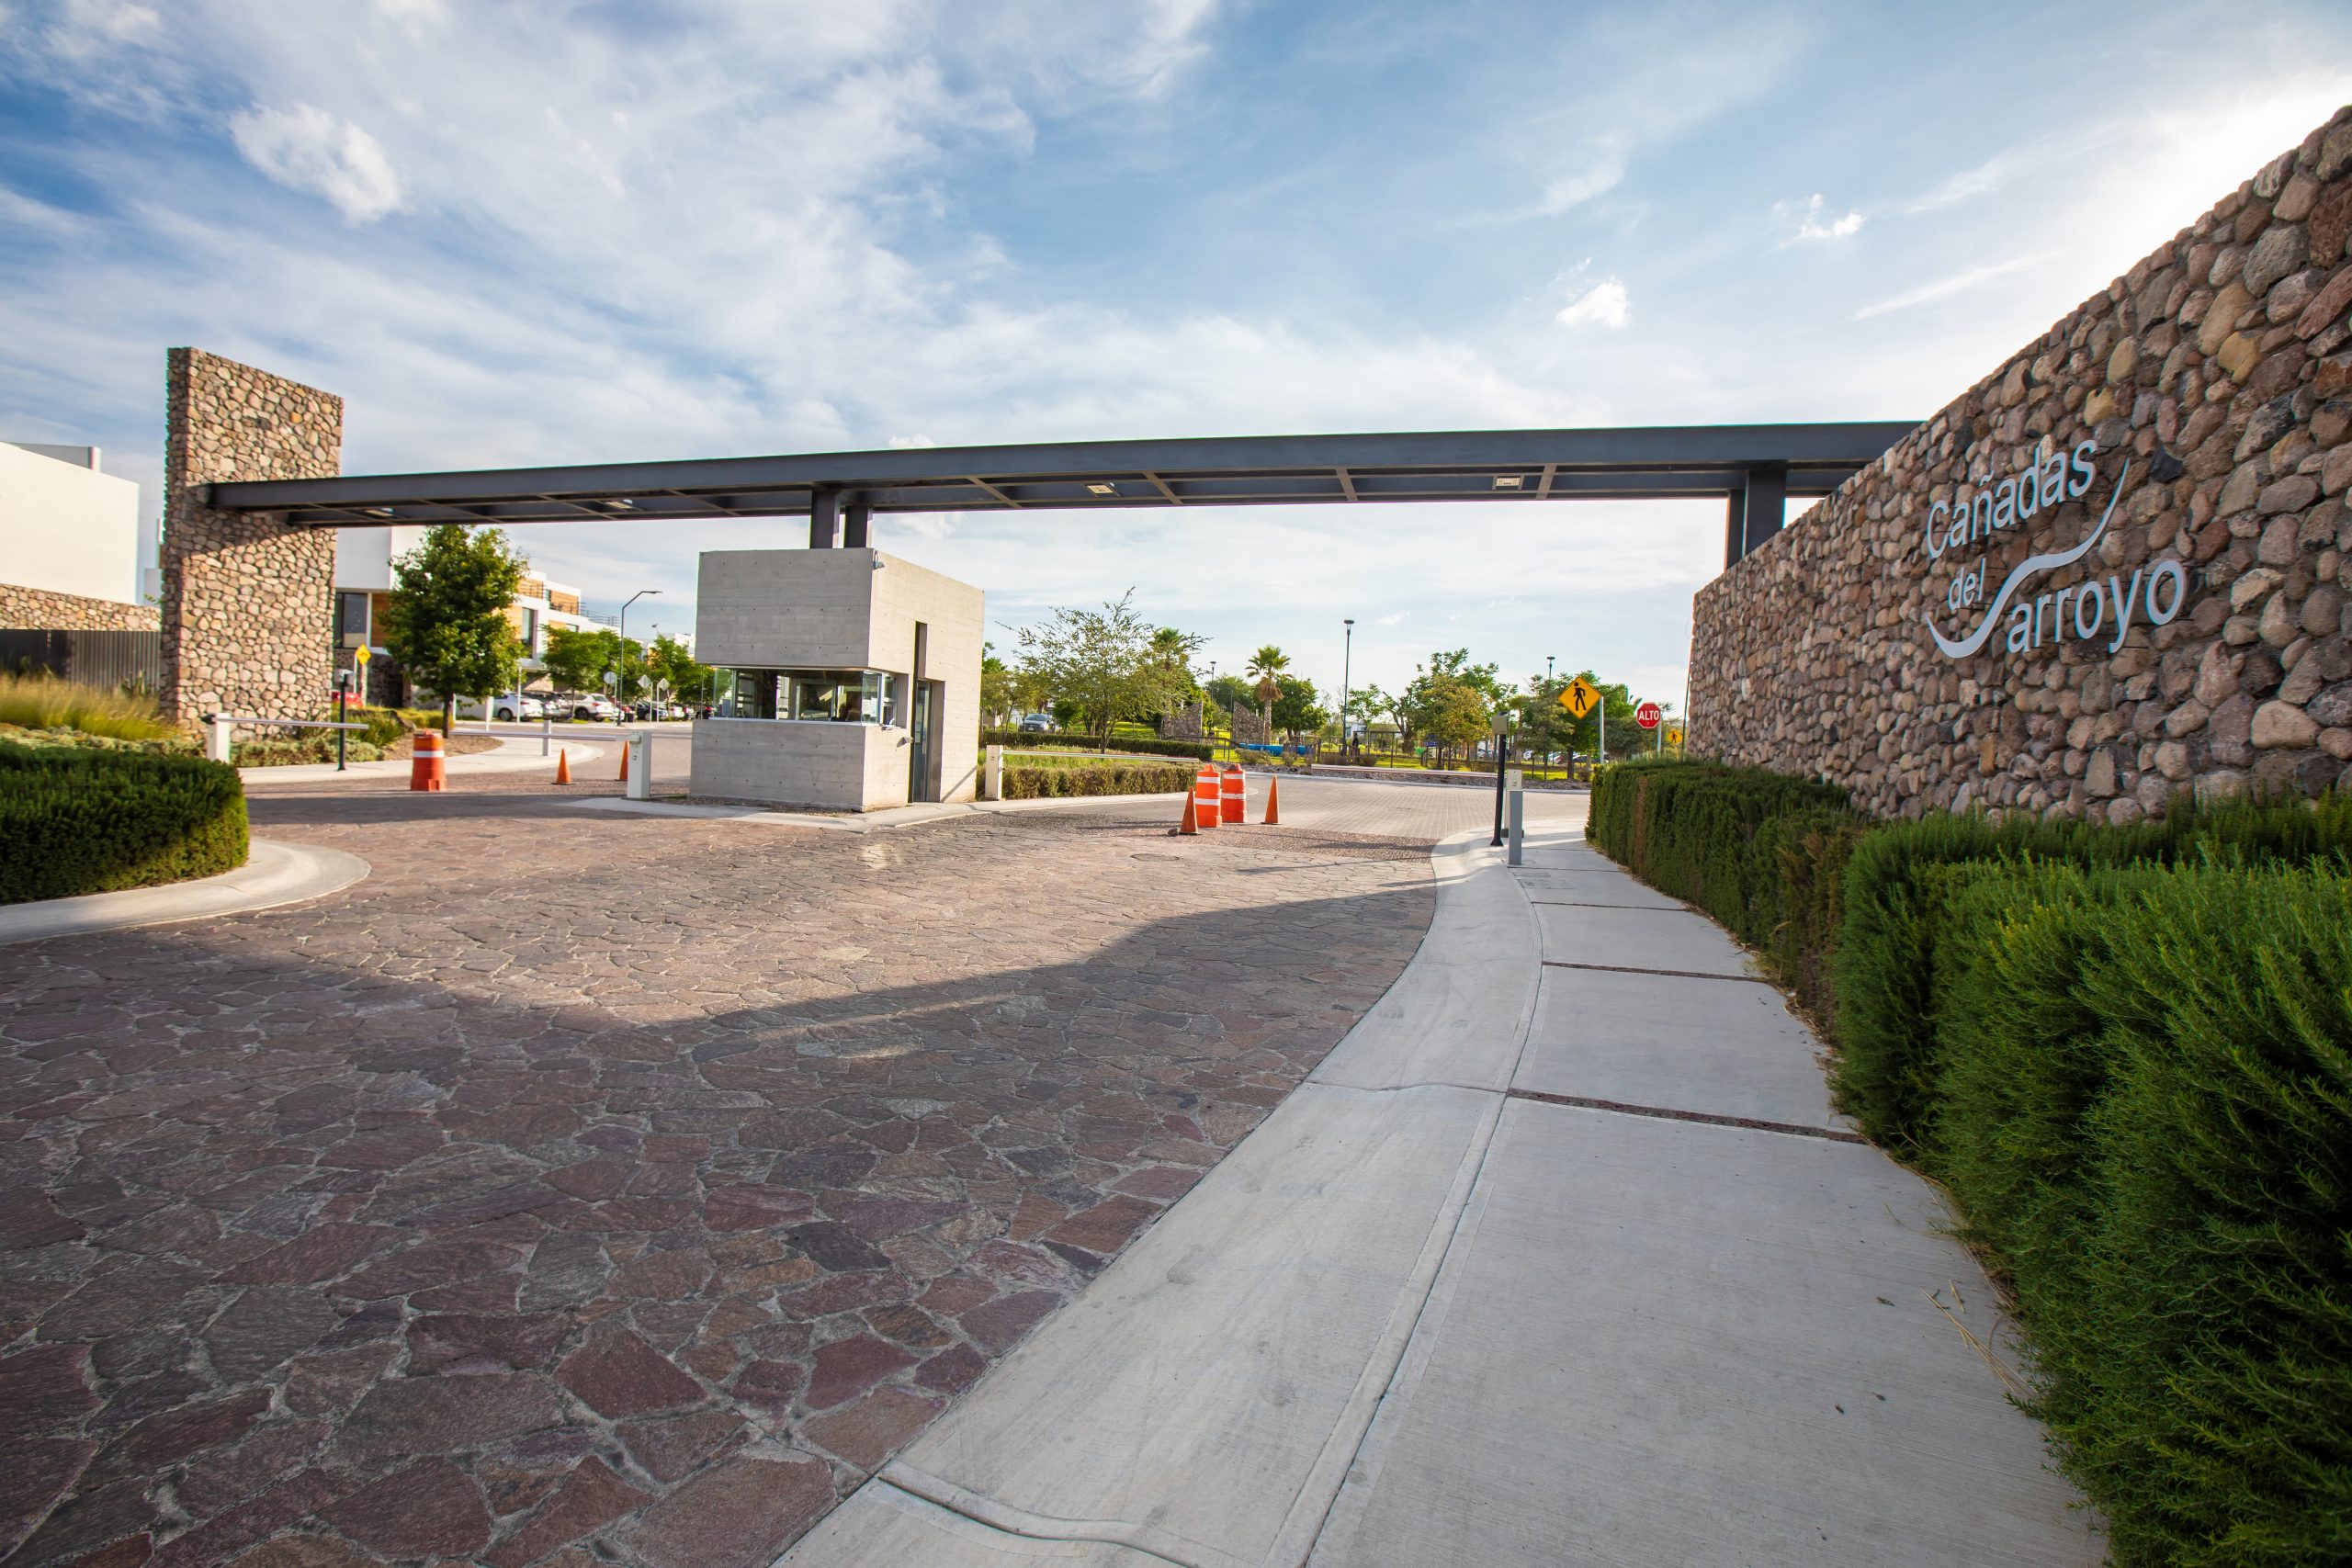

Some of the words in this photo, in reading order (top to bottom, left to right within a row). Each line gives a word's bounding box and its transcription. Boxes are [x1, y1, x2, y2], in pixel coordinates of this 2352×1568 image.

[1948, 558, 1986, 611] del
[2007, 559, 2188, 653] arroyo
[1638, 710, 1659, 721] ALTO
